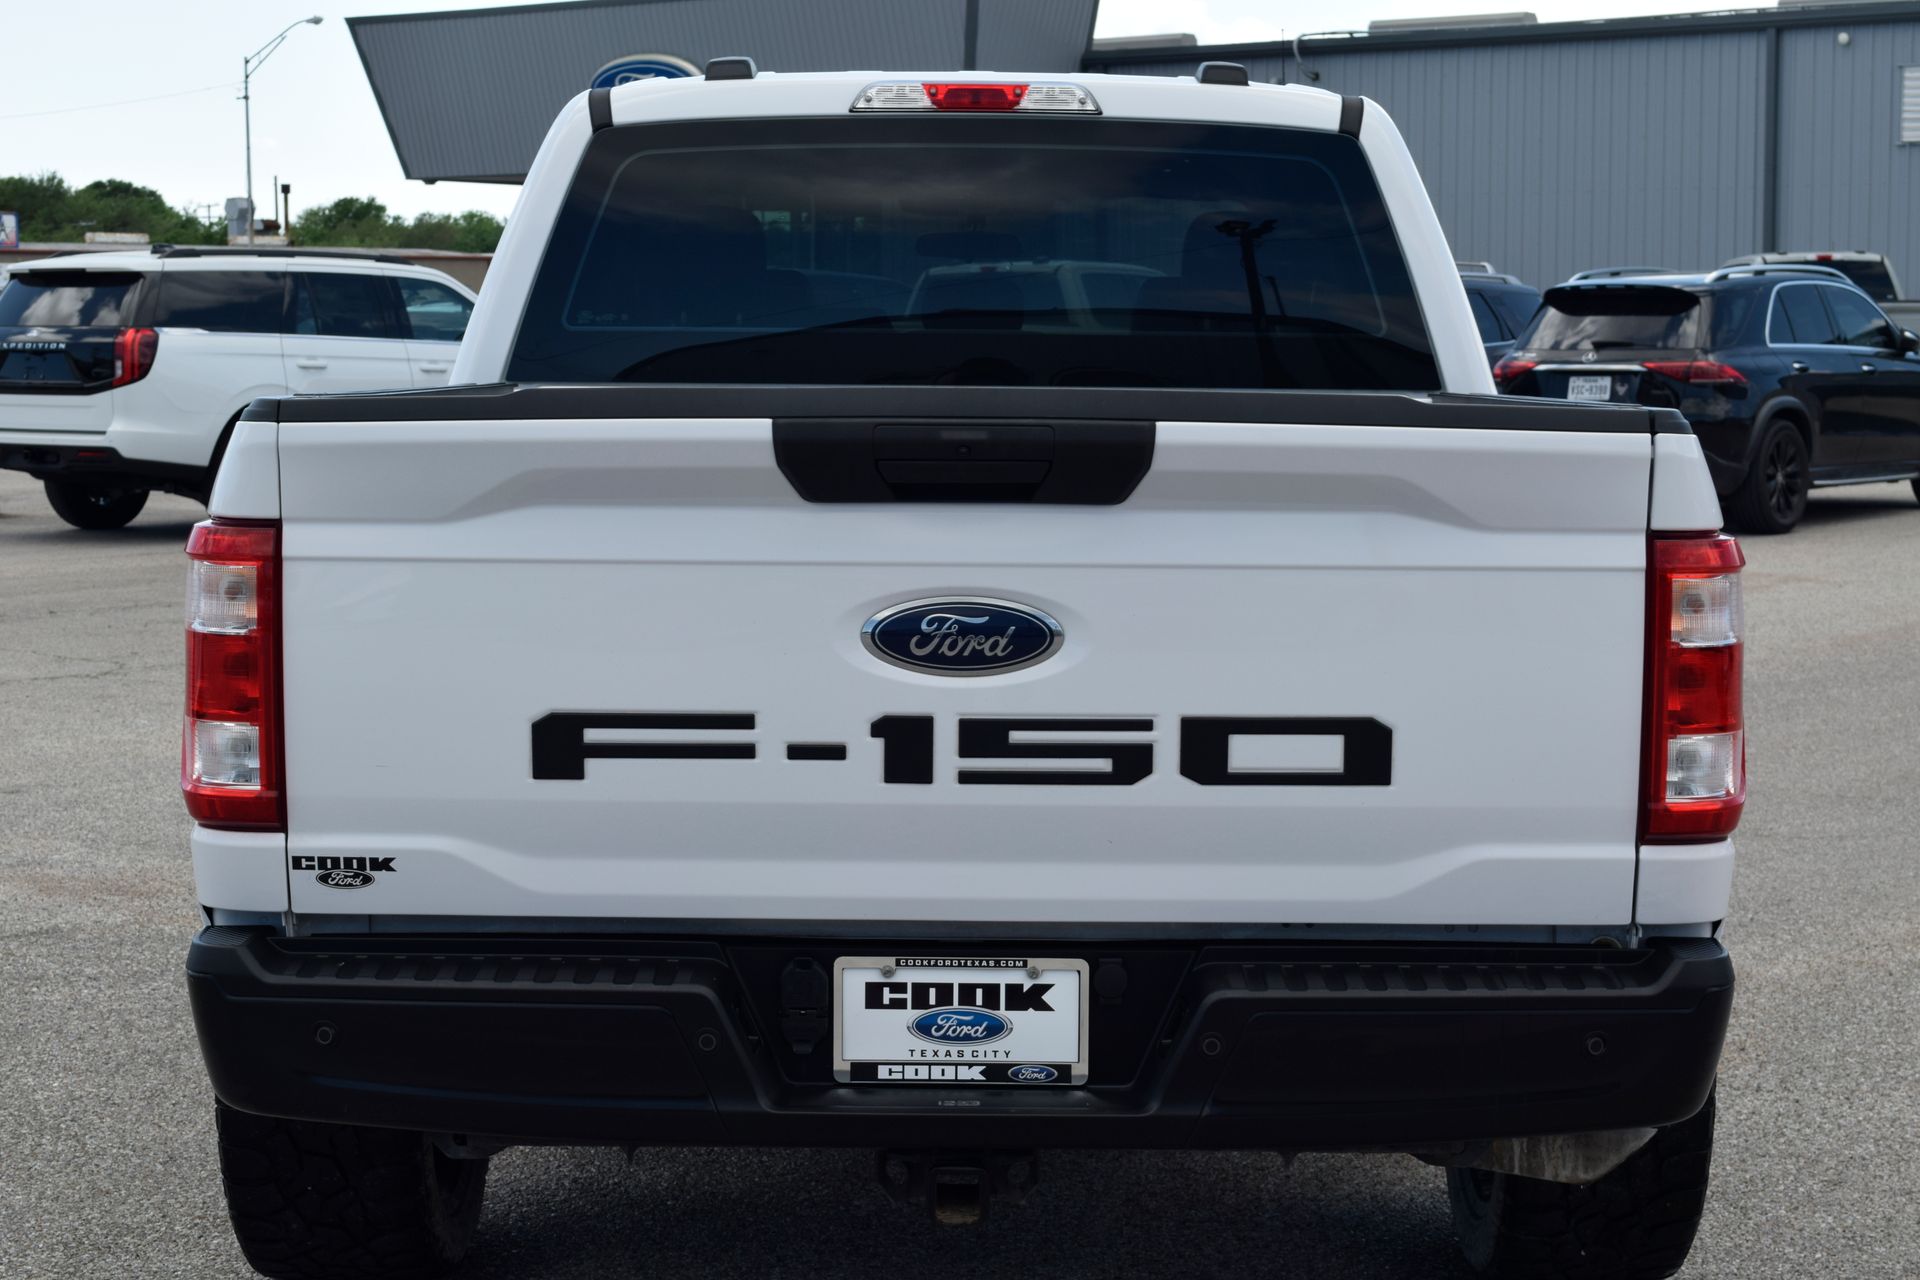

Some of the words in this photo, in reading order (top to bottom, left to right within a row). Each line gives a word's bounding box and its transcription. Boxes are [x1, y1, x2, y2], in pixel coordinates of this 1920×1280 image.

[909, 613, 1015, 656] Ford
[531, 711, 1393, 787] F-150
[291, 855, 397, 872] COOK
[328, 871, 363, 886] Ford
[865, 981, 1056, 1012] COOK
[931, 1013, 987, 1038] Ford
[908, 1049, 965, 1059] TEXAS
[971, 1049, 1012, 1059] CITY
[877, 1064, 987, 1081] COOK
[1018, 1067, 1047, 1080] Ford
